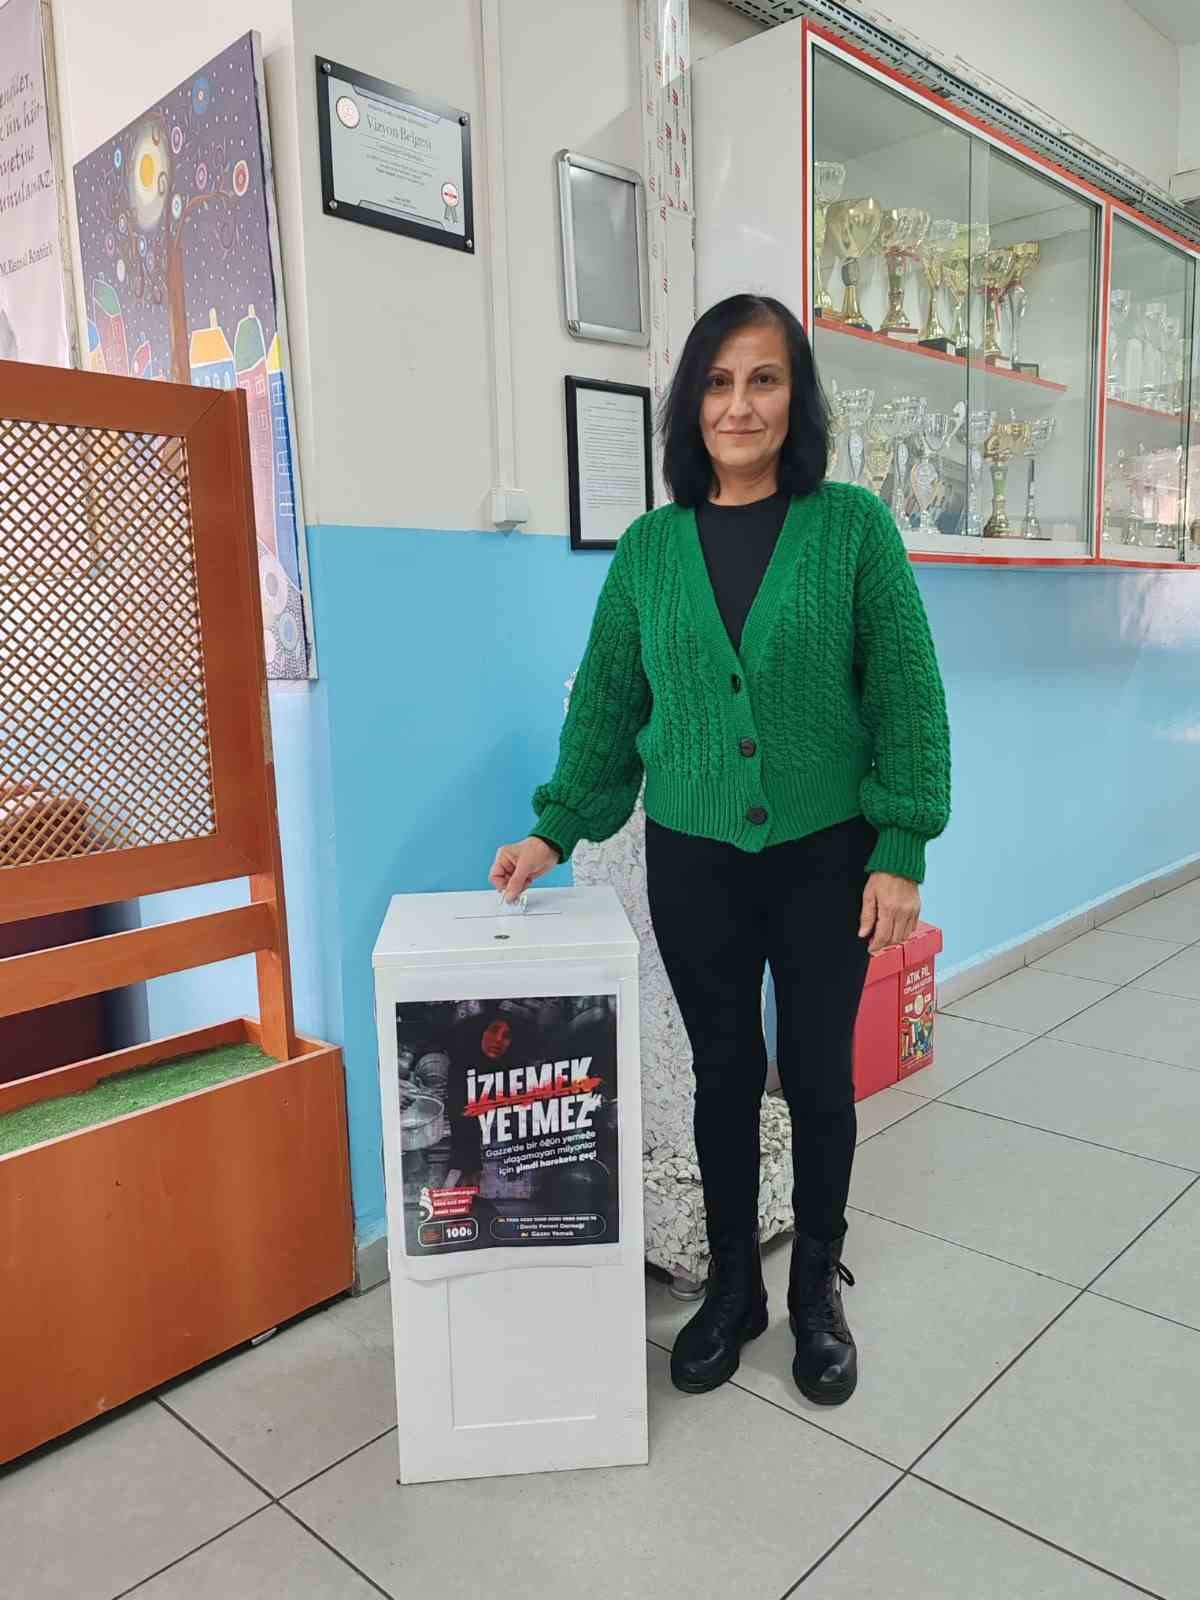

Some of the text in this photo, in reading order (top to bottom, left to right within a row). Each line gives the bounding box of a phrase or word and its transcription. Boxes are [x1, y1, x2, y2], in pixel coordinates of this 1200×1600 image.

[366, 112, 398, 137] Vizyon
[466, 1056, 593, 1106] İZLEMEK
[478, 1092, 597, 1145] YETMEZ
[485, 1144, 525, 1158] Gazze'de
[526, 1141, 538, 1150] bir
[503, 1140, 596, 1165] ulaşamayan milyonlar
